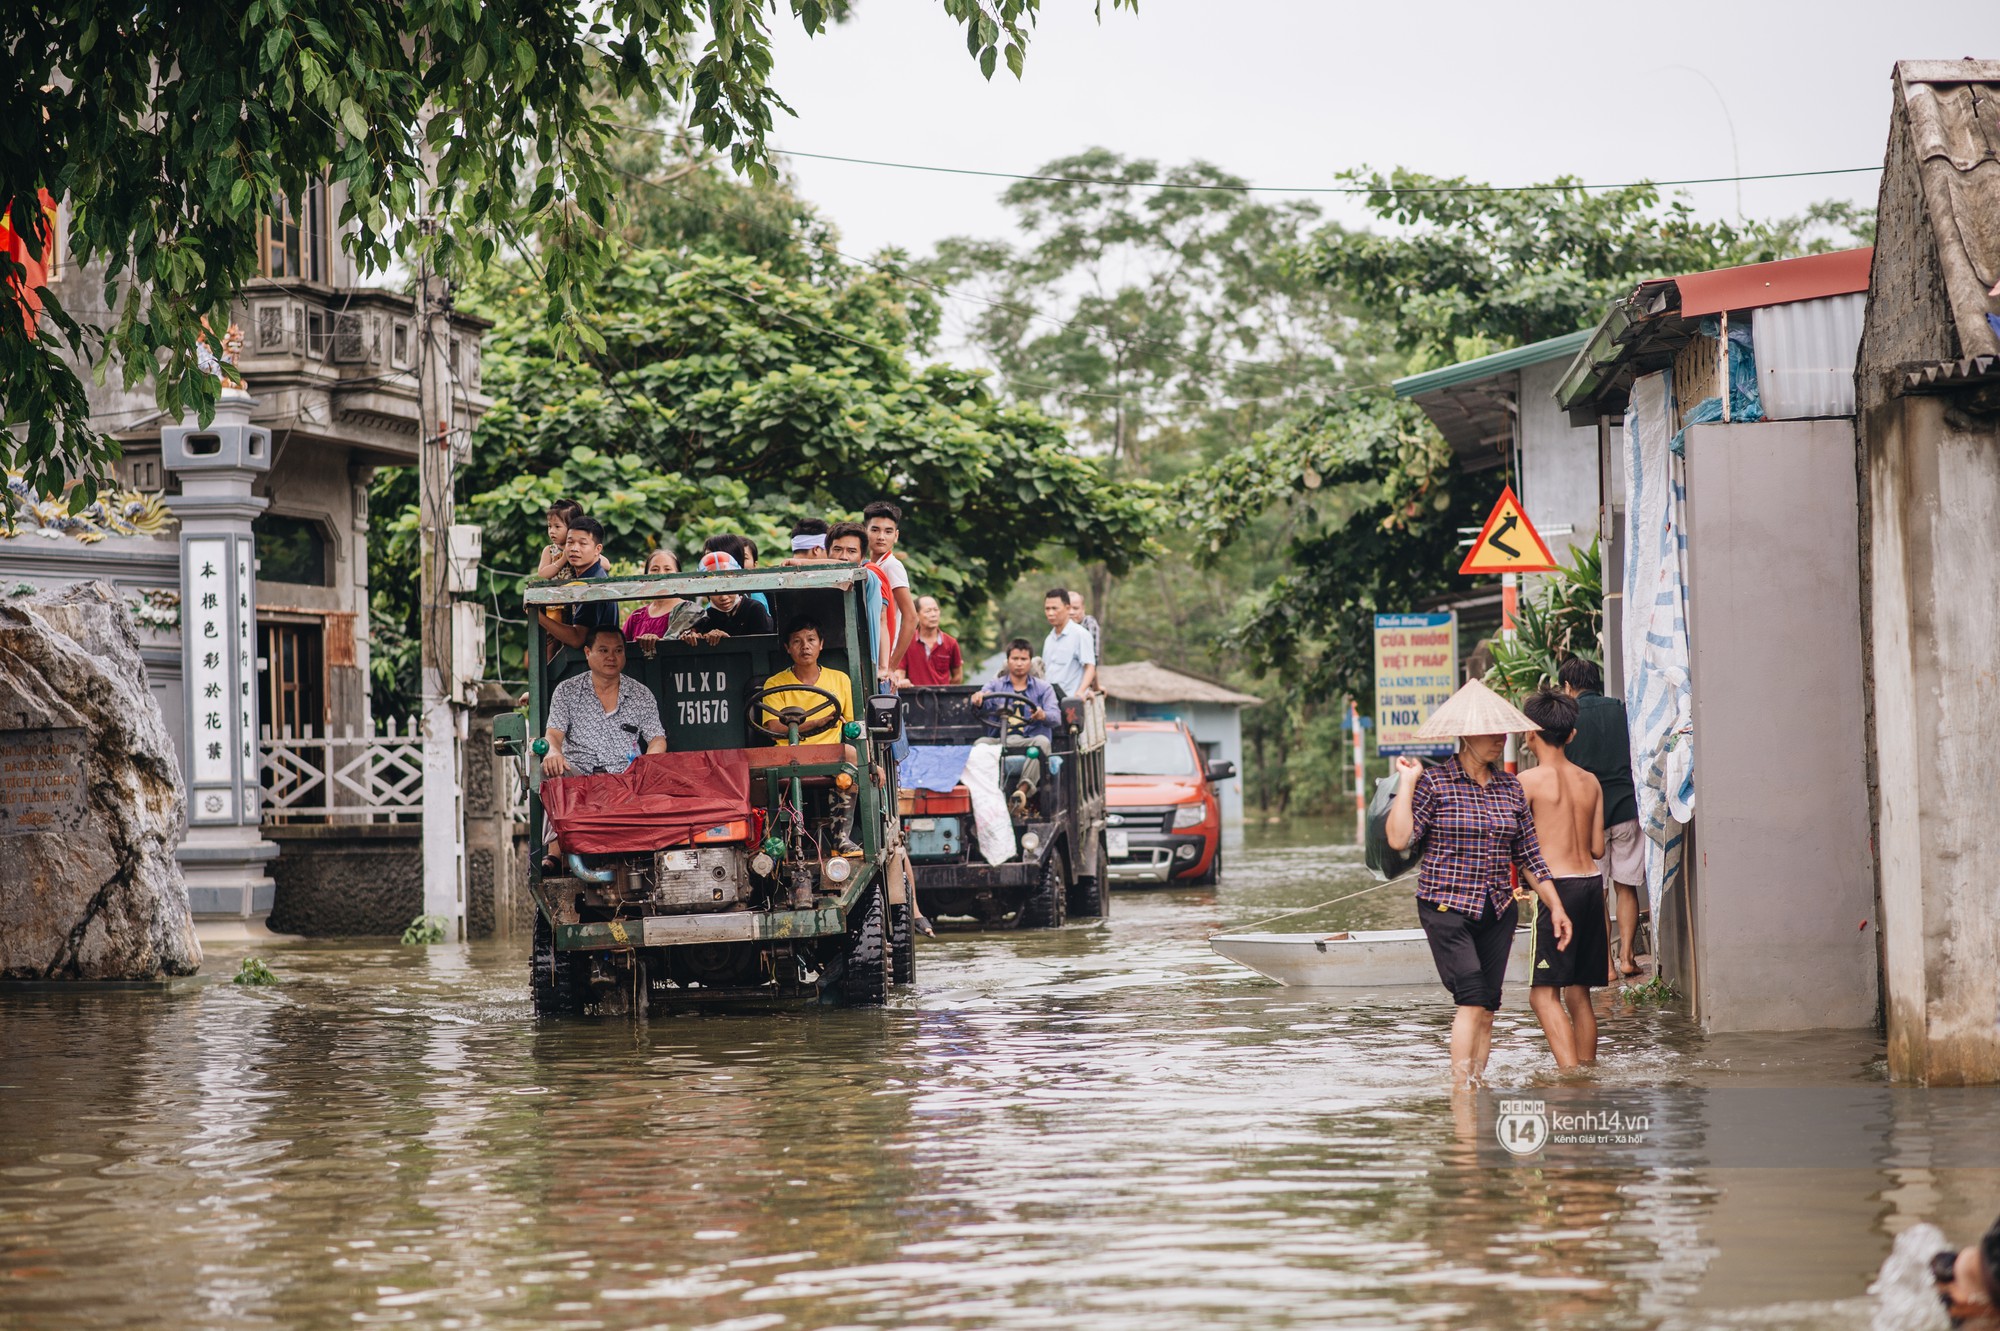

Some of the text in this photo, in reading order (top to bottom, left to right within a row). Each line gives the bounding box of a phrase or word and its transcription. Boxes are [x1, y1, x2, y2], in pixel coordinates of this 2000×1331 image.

[1411, 632, 1450, 646] NHÔM
[1382, 651, 1449, 670] VIỆT PHÁP
[677, 699, 729, 725] 751576
[1391, 710, 1420, 726] NOX
